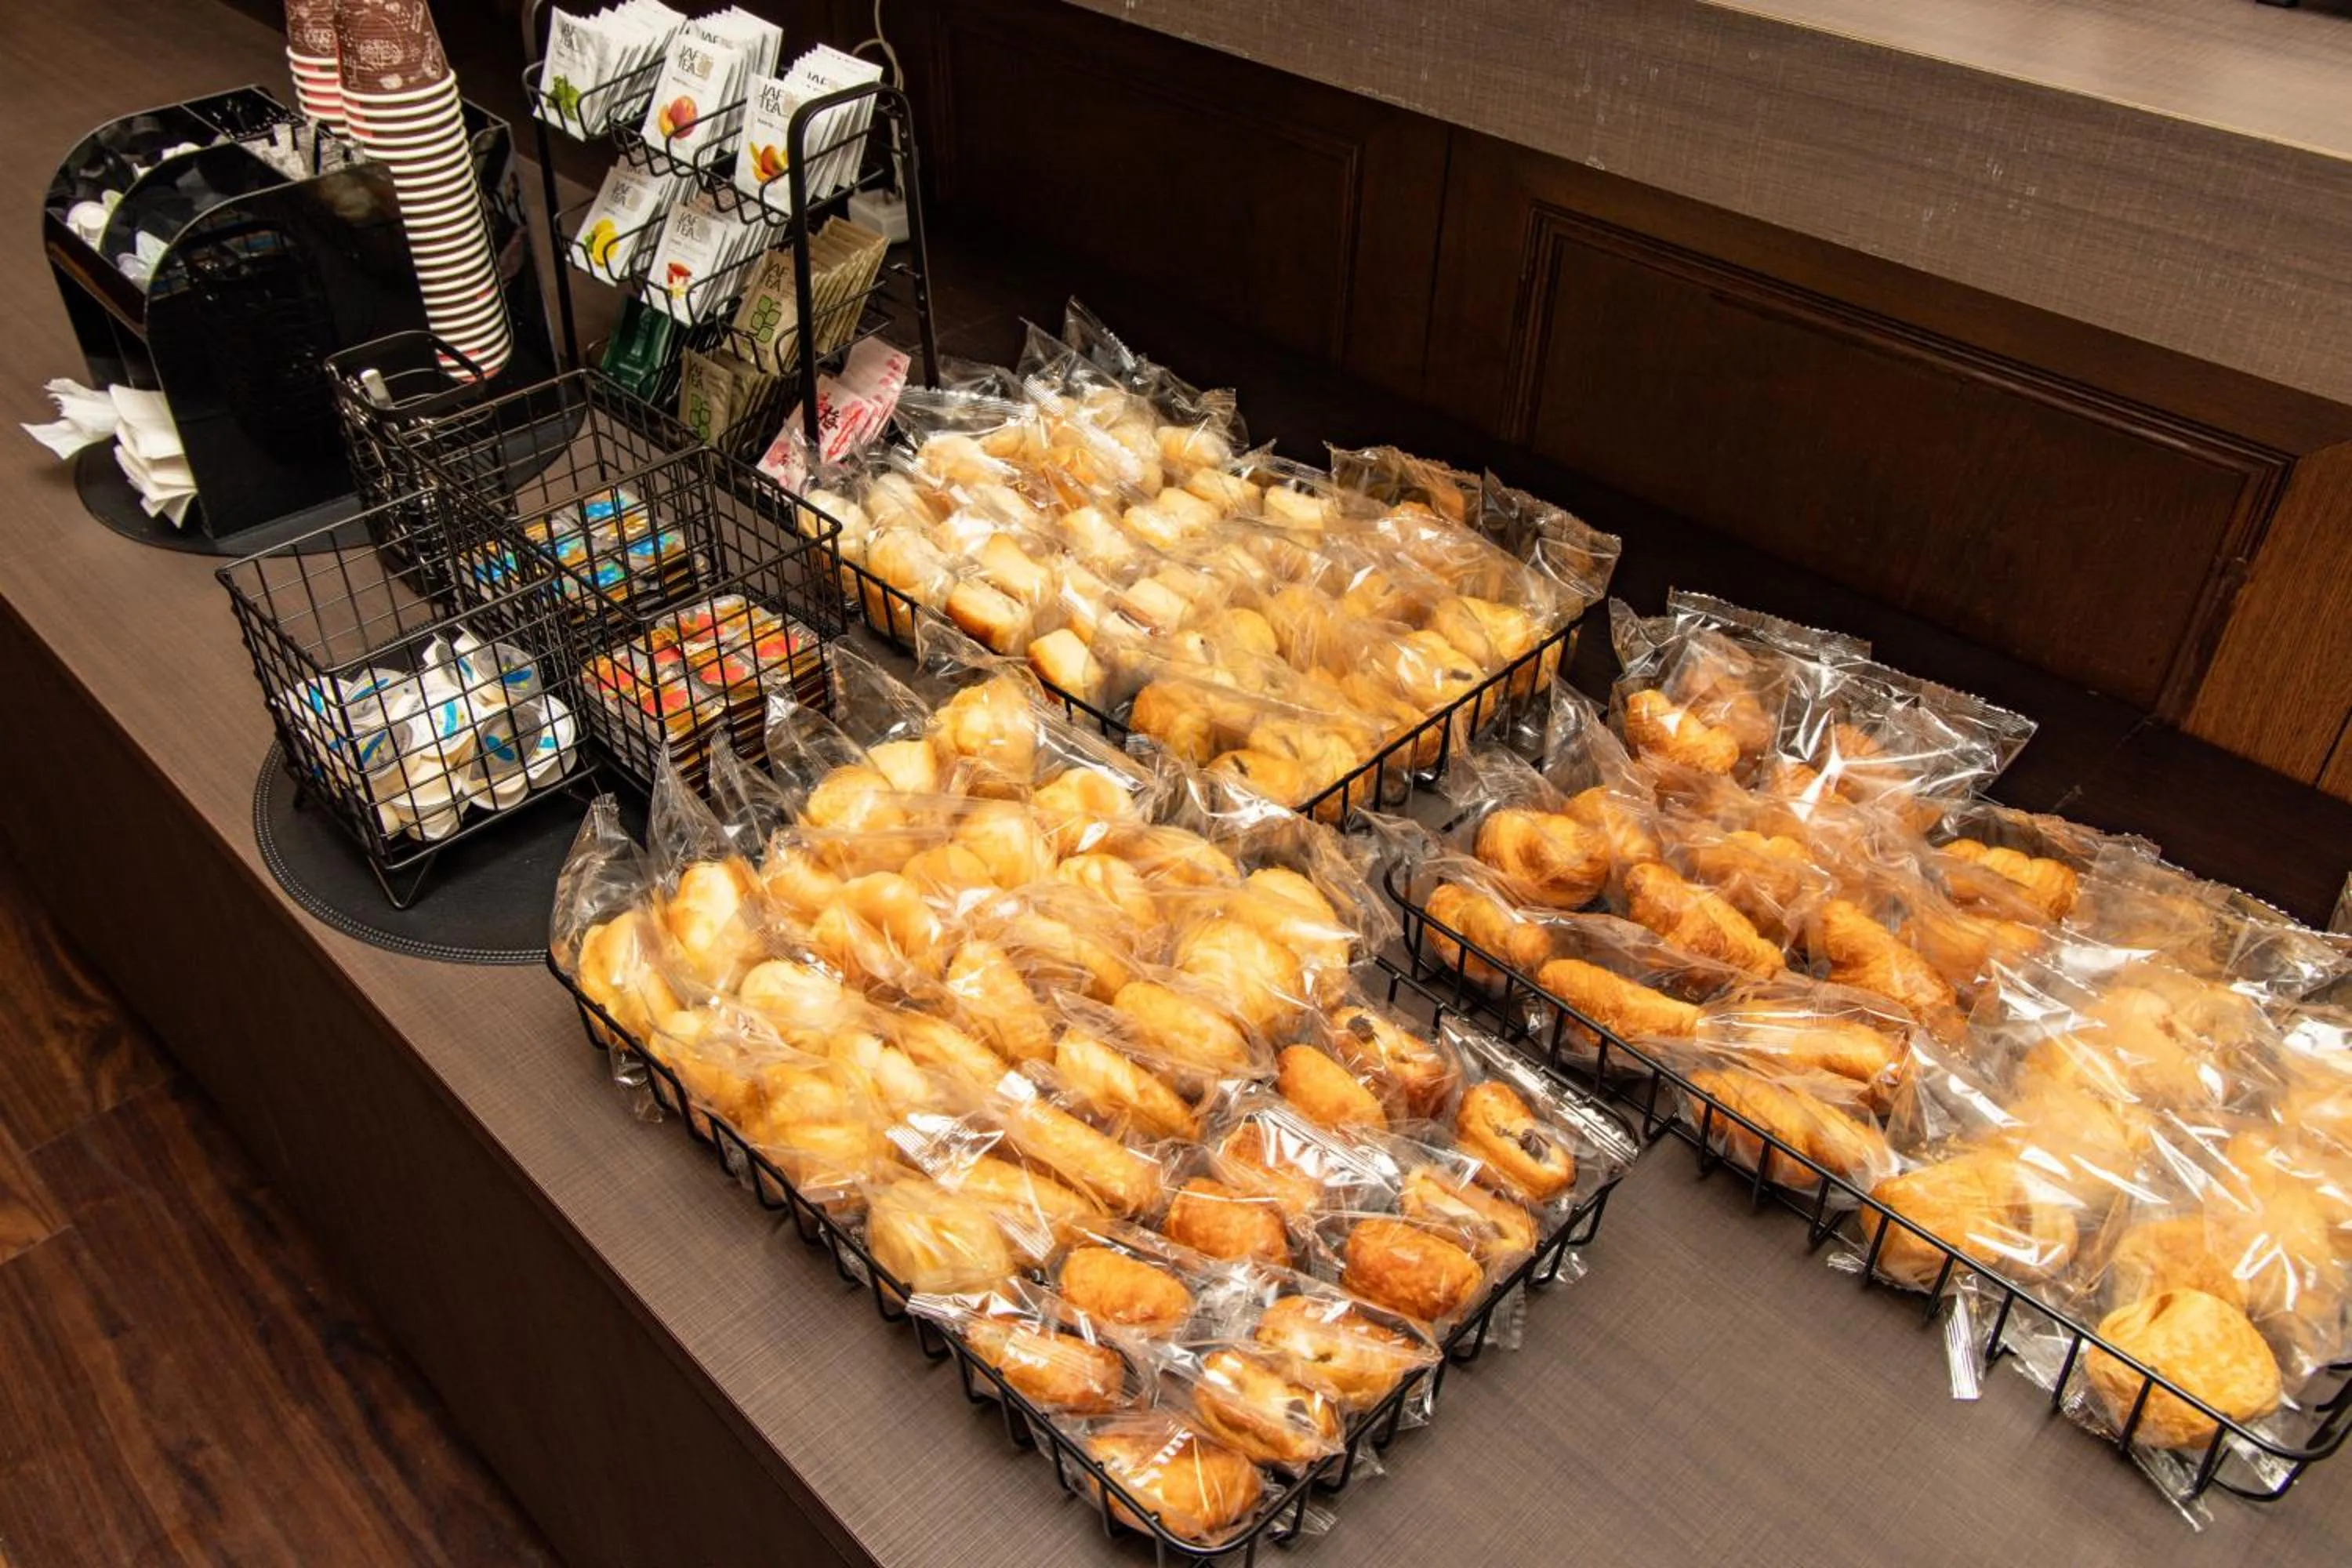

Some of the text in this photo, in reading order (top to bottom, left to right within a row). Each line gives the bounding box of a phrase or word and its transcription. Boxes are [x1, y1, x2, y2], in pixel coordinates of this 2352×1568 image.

[680, 45, 699, 61] JAF
[678, 58, 695, 74] TEA
[763, 84, 784, 100] JAF
[760, 96, 782, 116] TEA
